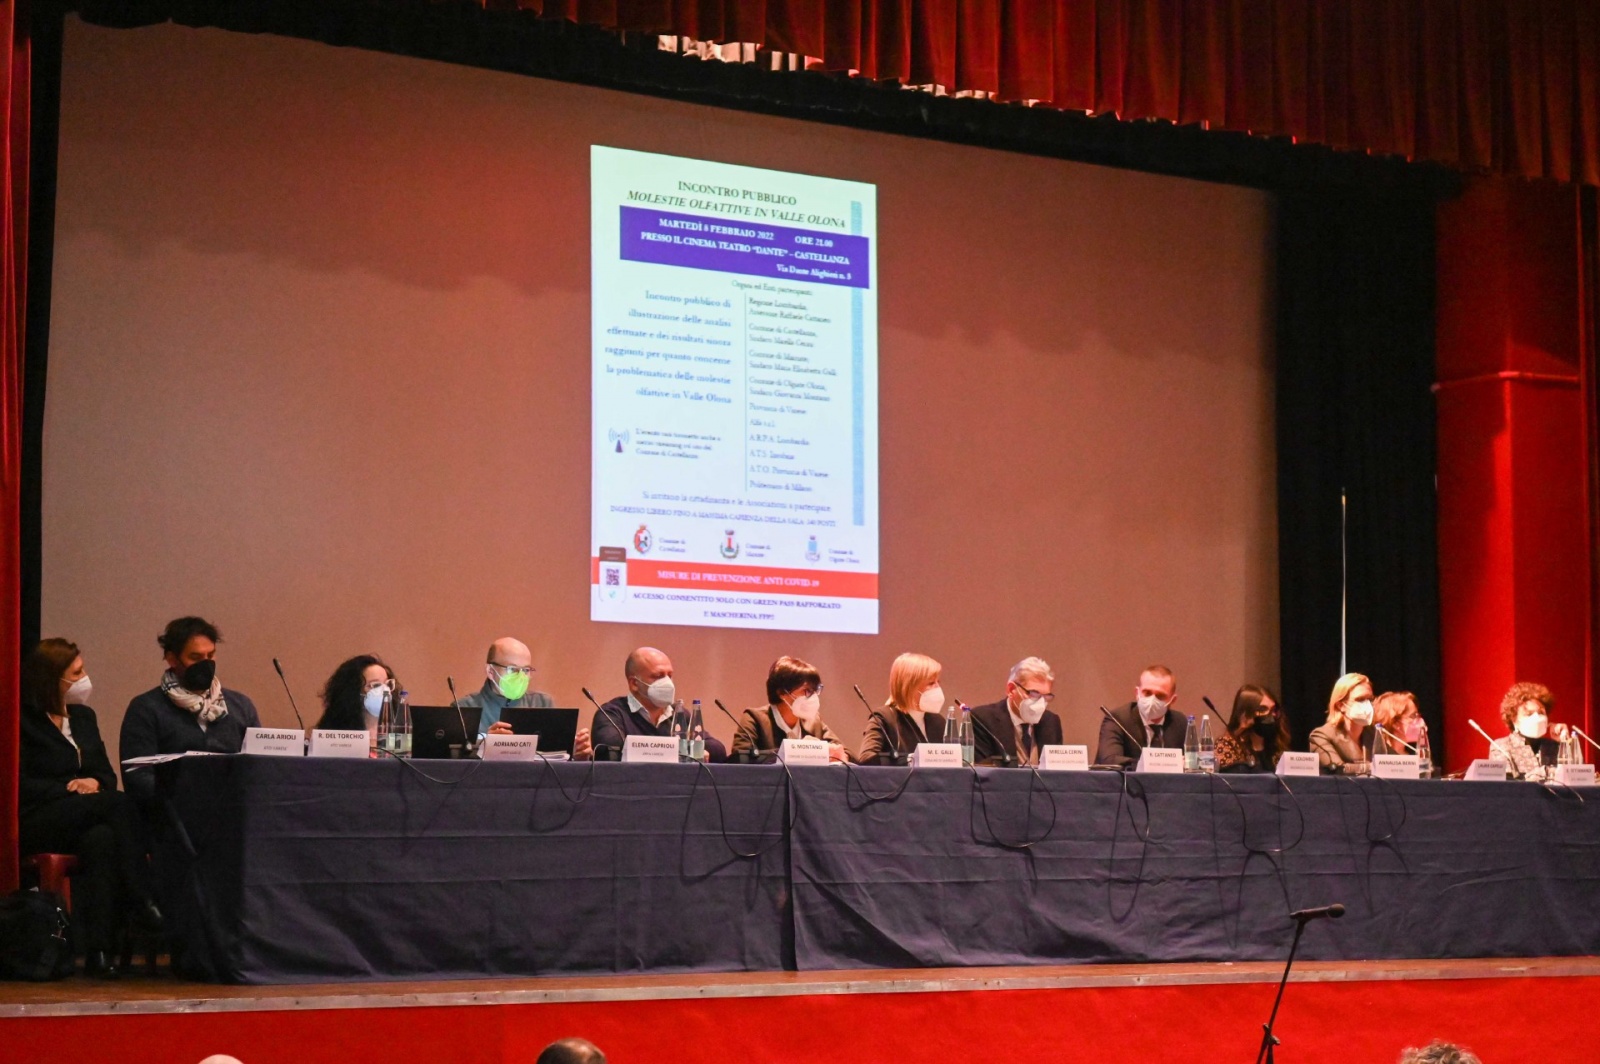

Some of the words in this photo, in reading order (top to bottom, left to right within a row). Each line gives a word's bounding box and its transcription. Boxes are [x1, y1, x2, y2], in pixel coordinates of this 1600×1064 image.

[678, 180, 739, 198] INCONTRO
[742, 189, 798, 206] PUBBLICO
[627, 190, 687, 207] MOLESTIE
[690, 199, 752, 216] OLFATTIVE
[754, 207, 768, 218] IN
[772, 209, 806, 223] VALLE
[807, 214, 846, 228] OLONA
[658, 217, 702, 232] MARTEDÌ
[710, 224, 756, 238] FEBBRAIO
[757, 231, 775, 241] 2022
[794, 236, 814, 246] ORE
[816, 238, 834, 248] 21.00
[641, 231, 673, 243] PRESSO
[674, 235, 682, 244] IL
[683, 236, 718, 249] CINEMA
[718, 241, 752, 253] TEATRO
[794, 250, 850, 265] CASTELLANZA
[776, 264, 789, 273] Via
[790, 266, 810, 275] Dante
[810, 268, 839, 280] Alighieri
[645, 289, 682, 302] Incontro
[684, 296, 721, 306] pubblico
[722, 299, 732, 308] di
[628, 308, 680, 321] illustrazione
[682, 314, 702, 324] delle
[704, 318, 732, 328] analisi
[606, 326, 647, 338] effettuate
[656, 330, 670, 340] dei
[672, 334, 704, 344] risultati
[604, 346, 644, 357] raggiunti
[646, 350, 661, 360] per
[662, 352, 692, 362] quanto
[694, 355, 732, 365] concerne
[606, 364, 614, 374] la
[616, 366, 672, 379] problematica
[674, 371, 695, 382] delle
[696, 374, 732, 384] molestie
[636, 387, 670, 398] olfattive
[672, 390, 681, 400] in
[682, 390, 704, 401] Valle
[706, 392, 732, 404] Olona
[610, 504, 646, 514] INGRESSO
[646, 508, 672, 516] LIBERO
[673, 510, 691, 518] FINO
[698, 511, 729, 521] MASSIMA
[730, 513, 764, 524] CAPIENZA
[764, 516, 786, 525] DELLA
[656, 569, 690, 582] MISURE
[690, 572, 701, 582] DI
[702, 572, 762, 585] PREVENZIONE
[763, 576, 784, 586] ANTI
[632, 592, 665, 601] ACCESSO
[666, 594, 714, 604] CONSENTITO
[716, 596, 735, 605] SOLO
[735, 598, 752, 606] CON
[752, 598, 778, 606] GREEN
[779, 600, 796, 608] PASS
[710, 610, 758, 620] MASCHERINA
[276, 733, 297, 741] ARIOLI
